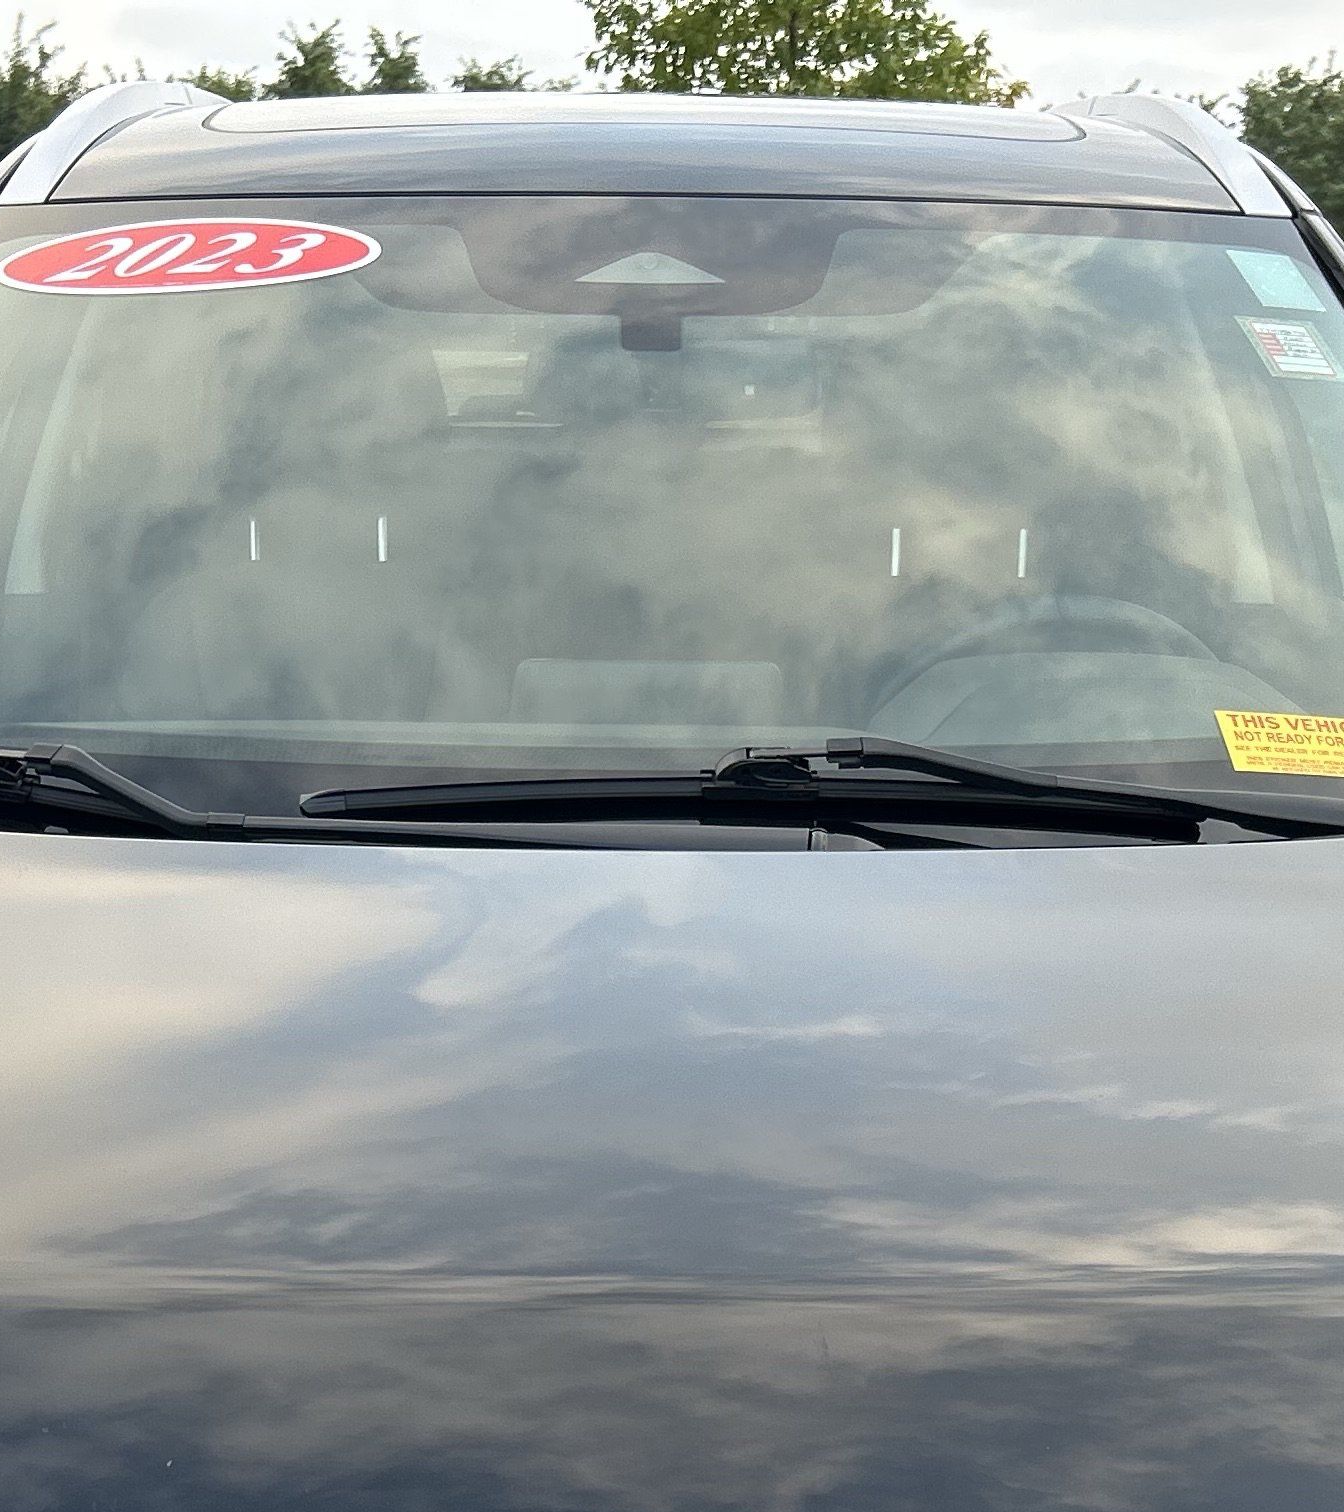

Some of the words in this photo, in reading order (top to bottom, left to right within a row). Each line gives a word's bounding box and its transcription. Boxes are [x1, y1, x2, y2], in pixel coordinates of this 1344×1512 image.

[42, 231, 327, 283] 2023
[1226, 713, 1281, 730] THIS
[1233, 730, 1262, 742] NOT
[1265, 732, 1312, 745] READY
